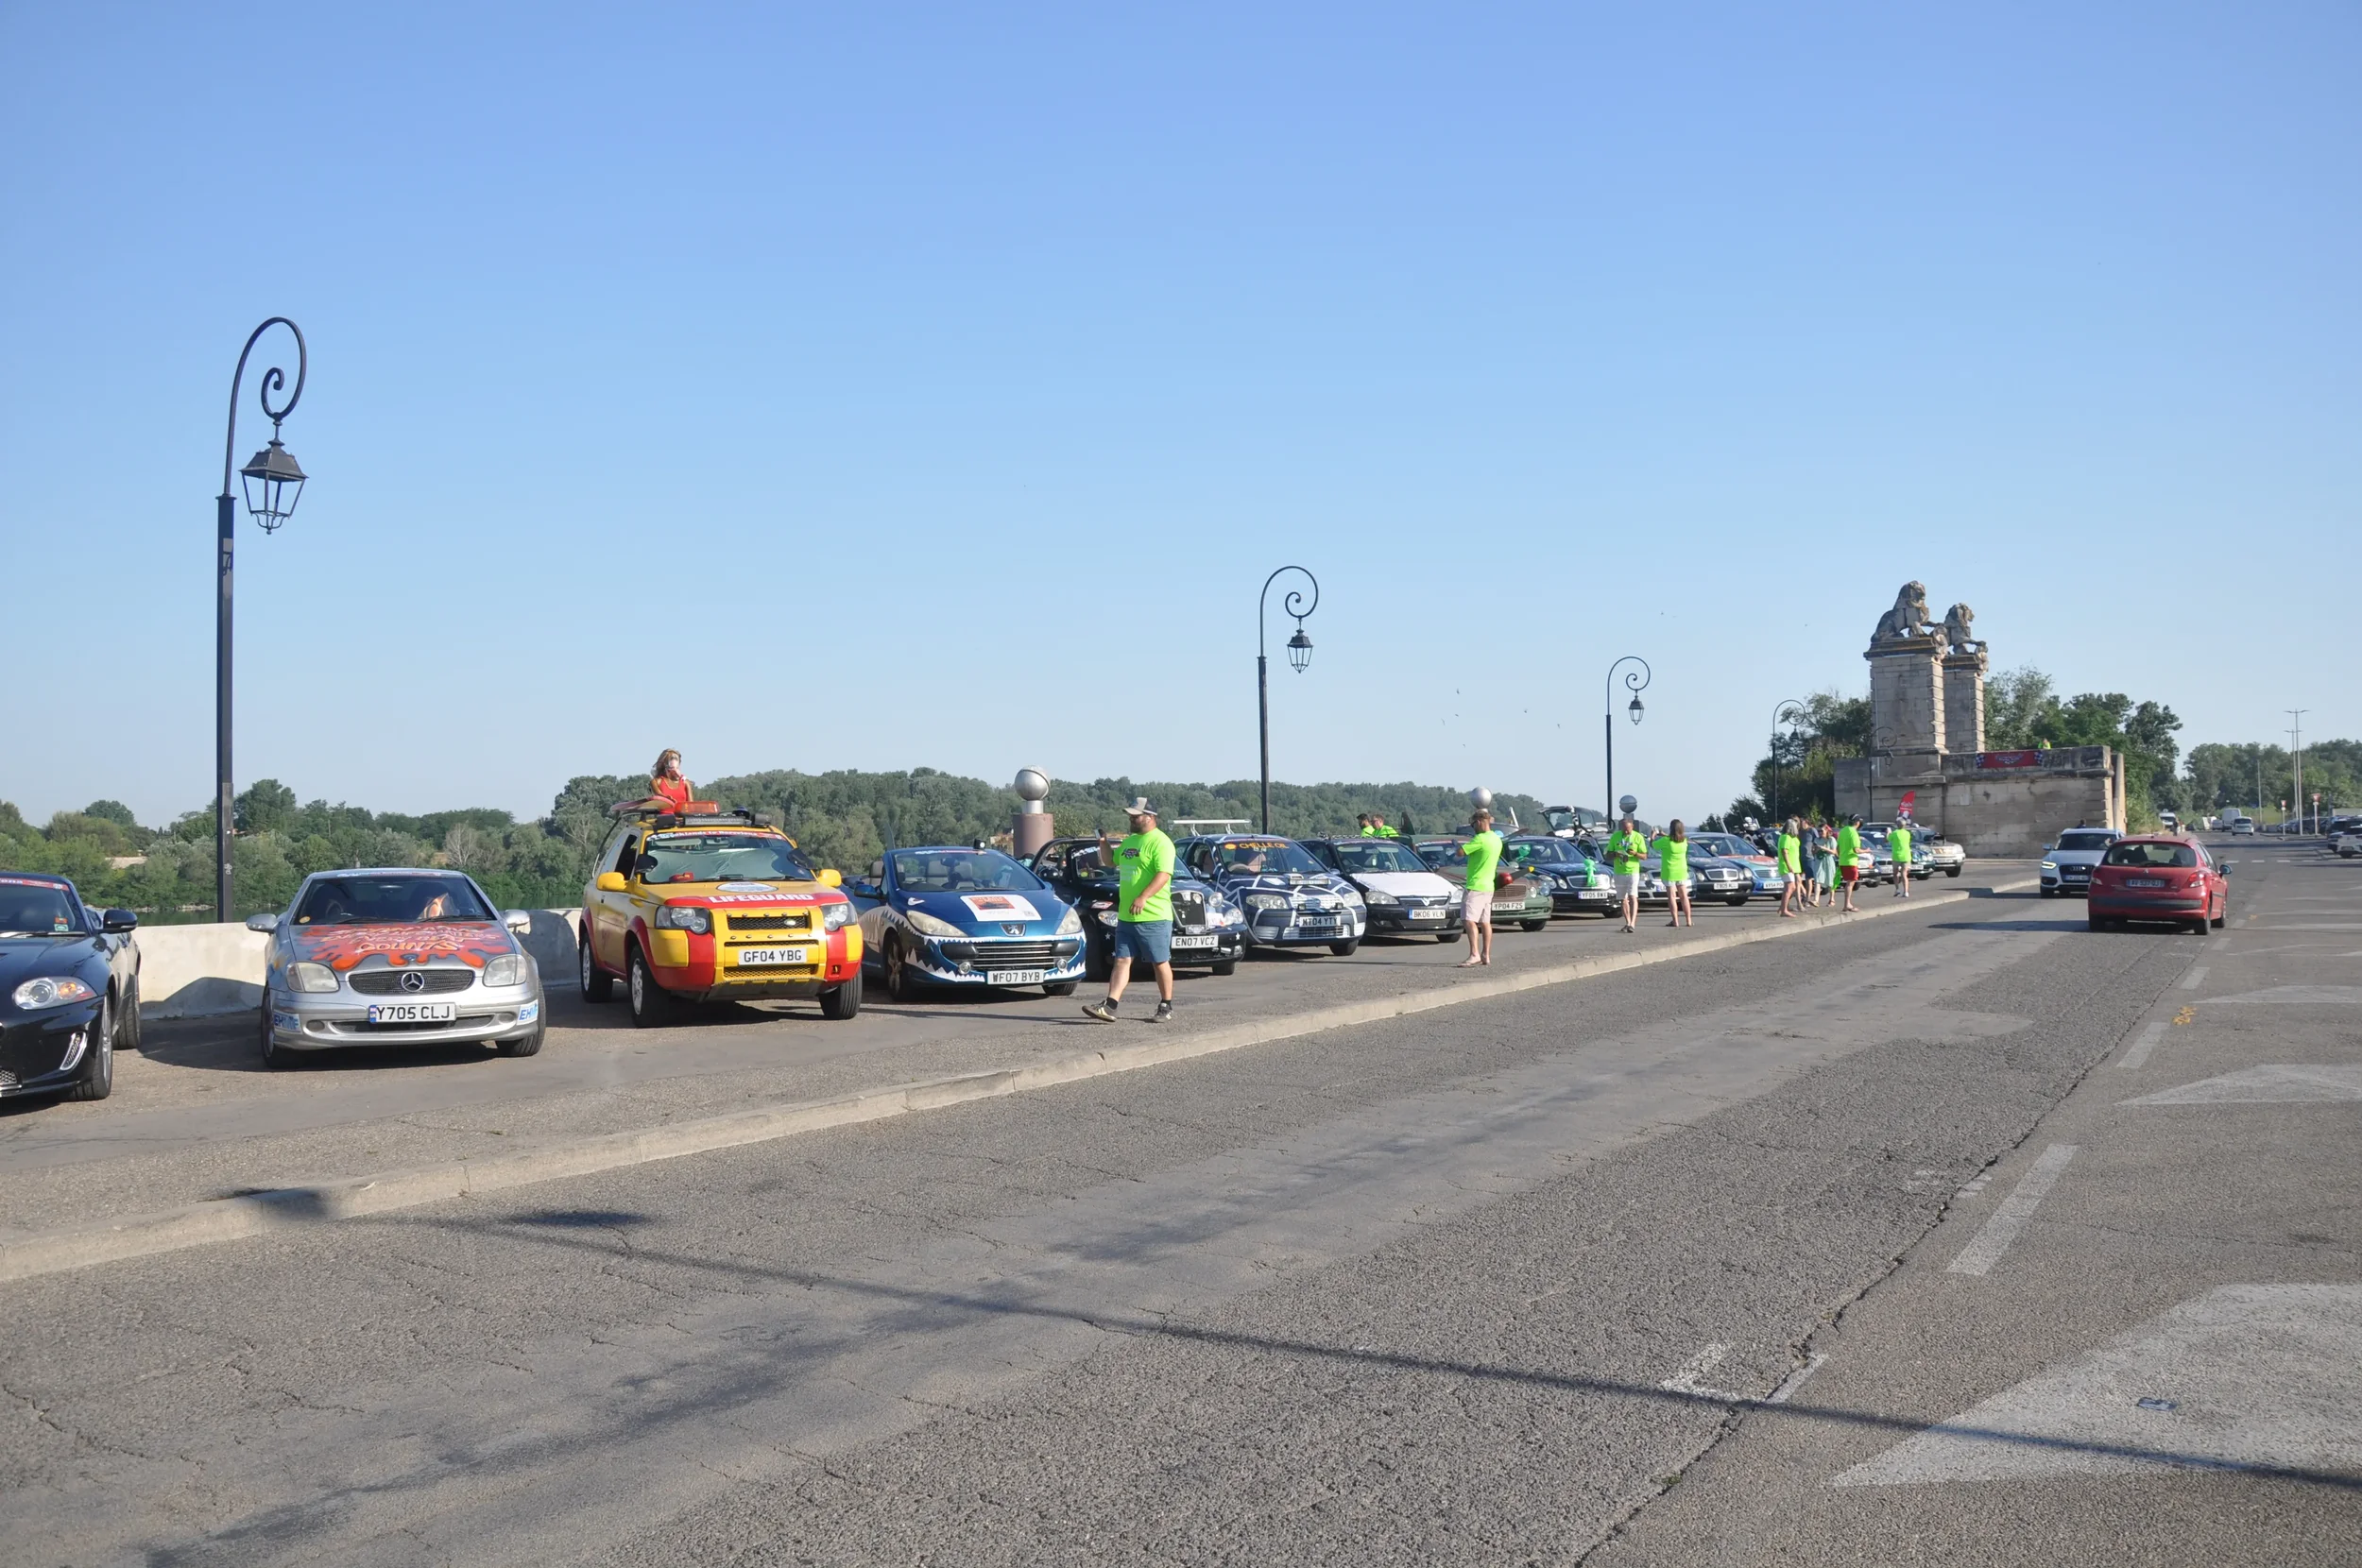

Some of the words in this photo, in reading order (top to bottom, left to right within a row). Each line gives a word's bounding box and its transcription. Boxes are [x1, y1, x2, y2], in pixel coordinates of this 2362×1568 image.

[710, 894, 814, 904] LIFEGUARD
[359, 940, 460, 952] COUNTS
[1175, 937, 1198, 946] EN07
[1200, 937, 1215, 946] VCZ
[744, 950, 776, 963] GF04
[779, 949, 802, 962] YBG
[992, 972, 1018, 983] WF07
[1020, 971, 1040, 982] BYB
[377, 1006, 417, 1020] Y705
[420, 1005, 450, 1019] CLJ
